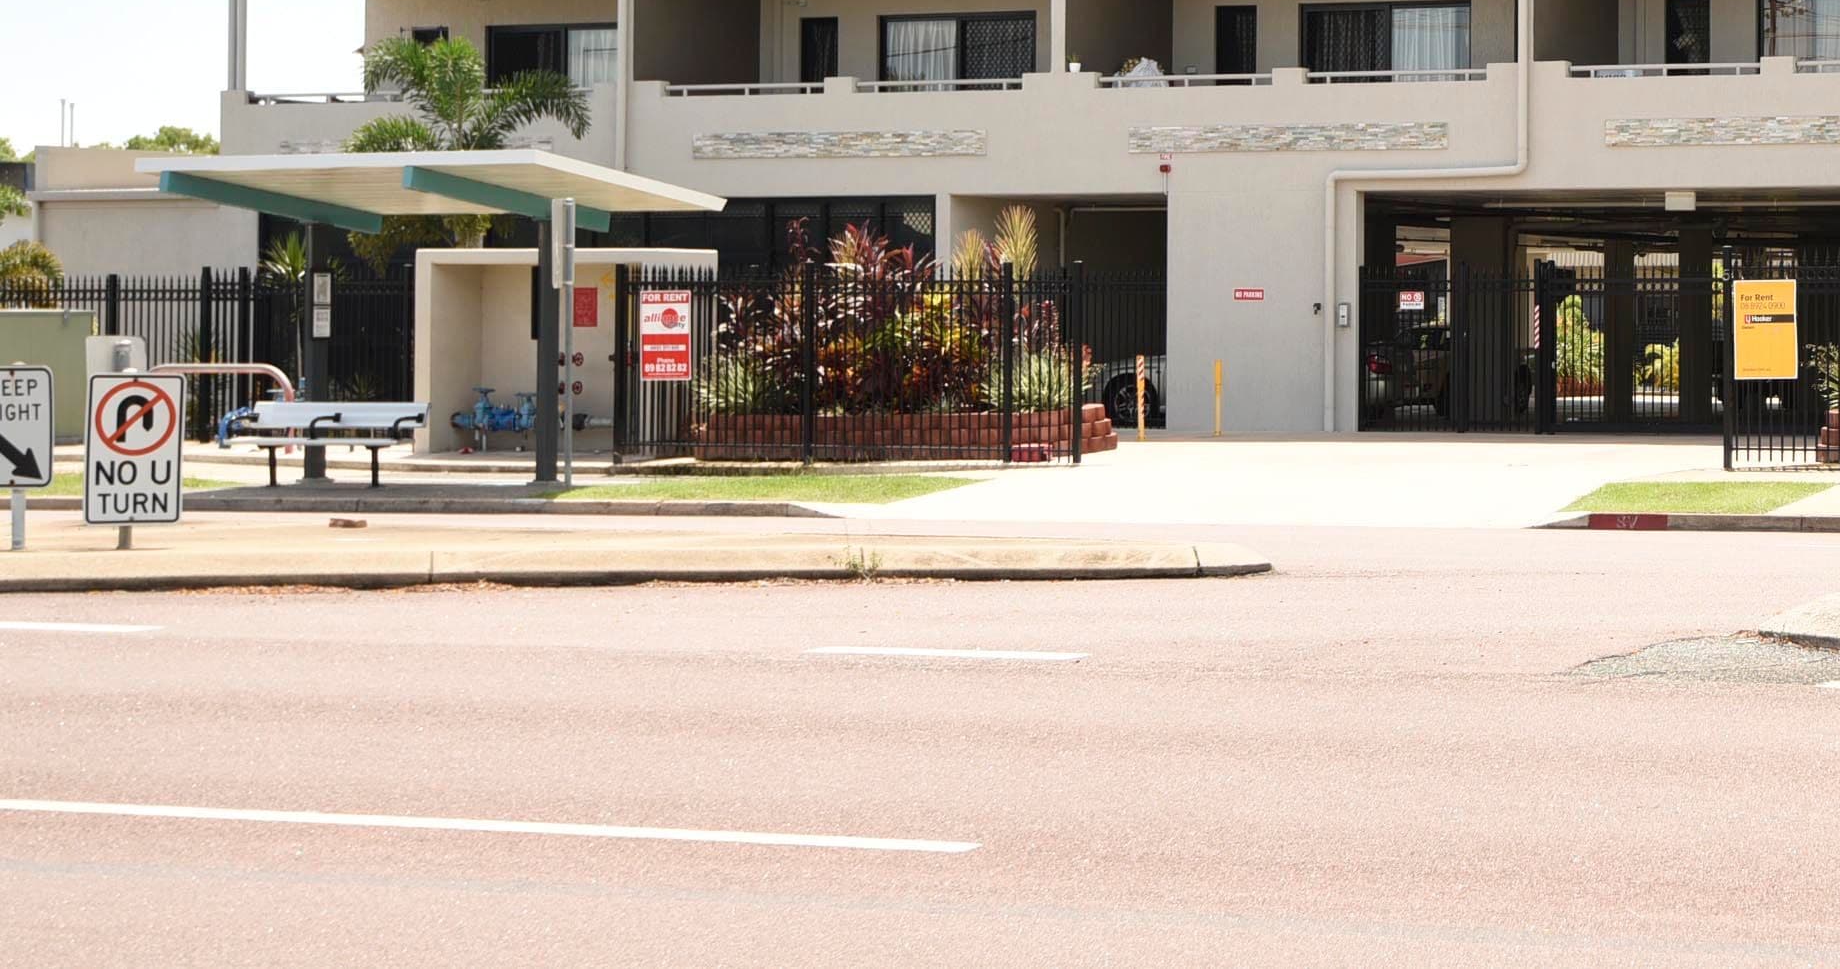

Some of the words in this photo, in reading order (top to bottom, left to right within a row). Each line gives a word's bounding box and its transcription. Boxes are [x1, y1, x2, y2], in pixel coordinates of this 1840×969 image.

[642, 293, 661, 302] FOR
[663, 293, 688, 302] RENT
[1401, 293, 1412, 301] NO
[2, 379, 38, 396] EEP
[0, 403, 41, 421] IGHT
[95, 460, 137, 486] NO
[151, 460, 171, 485] U
[97, 492, 168, 514] TURN
